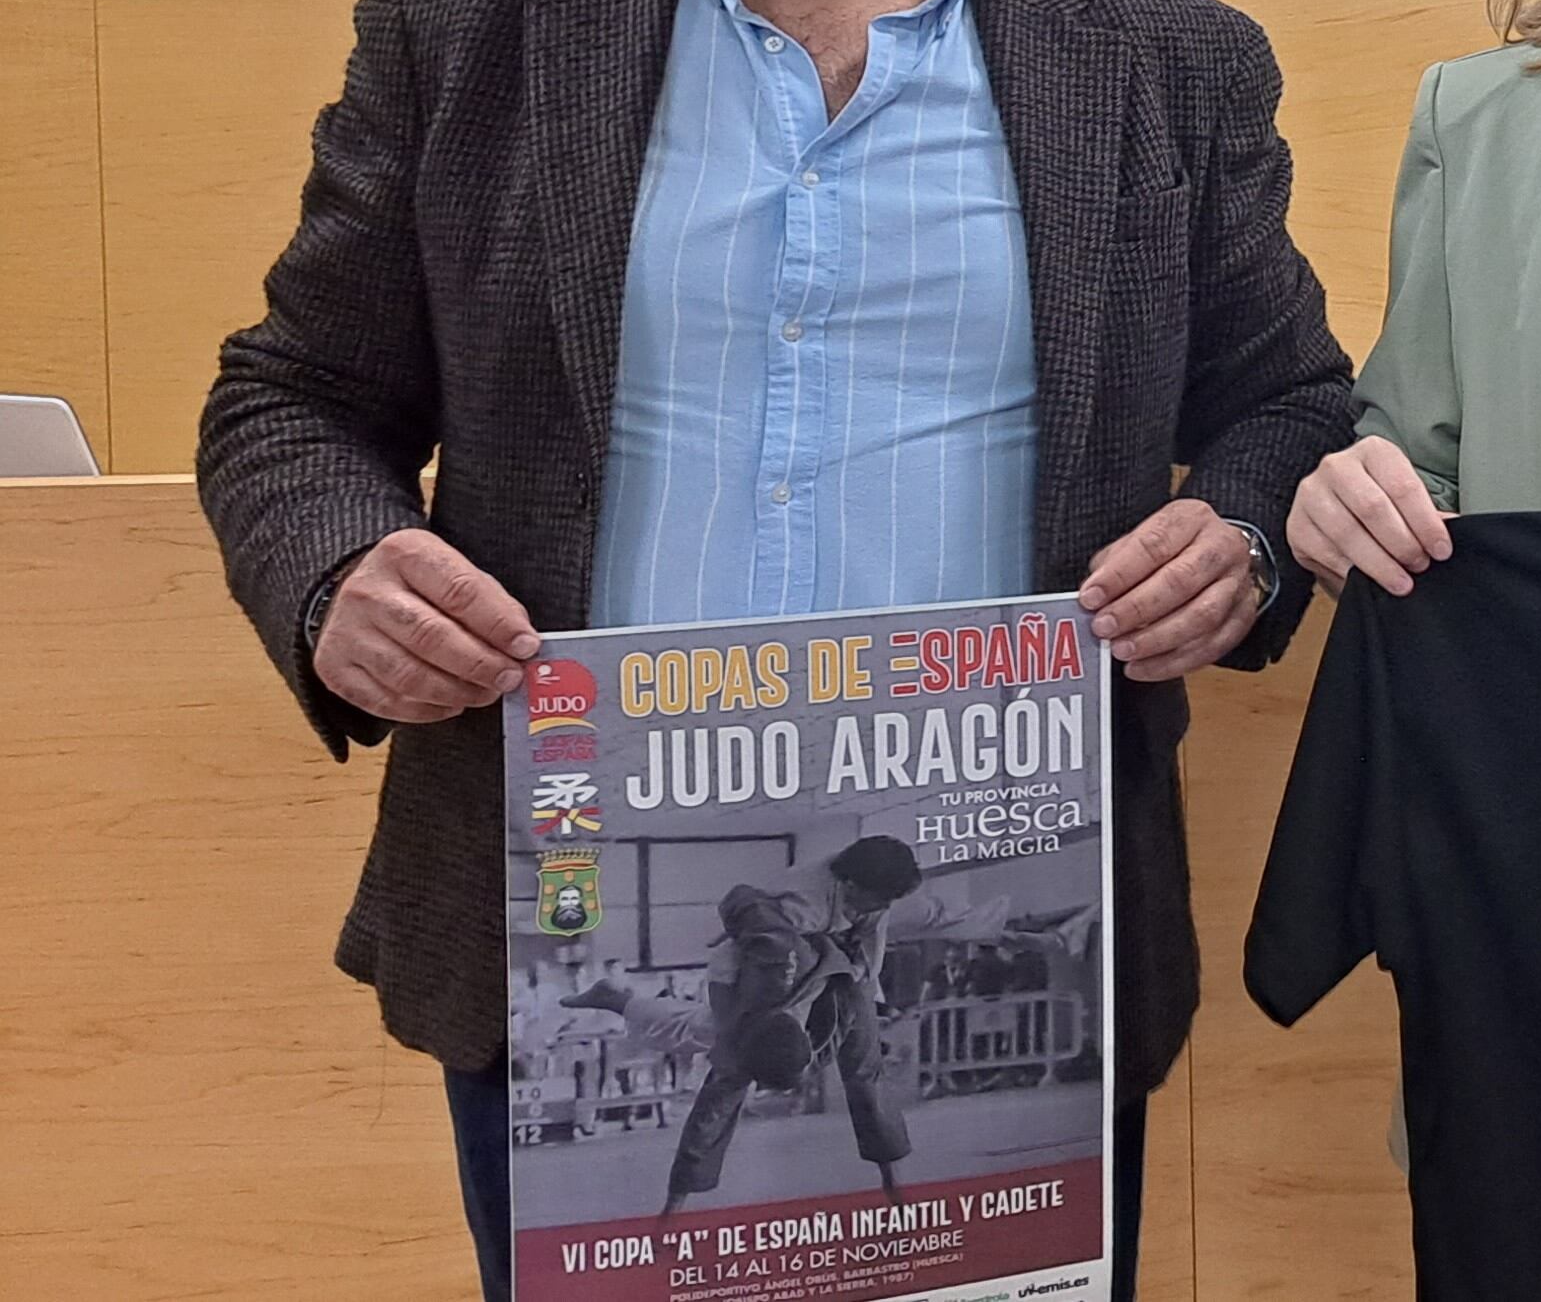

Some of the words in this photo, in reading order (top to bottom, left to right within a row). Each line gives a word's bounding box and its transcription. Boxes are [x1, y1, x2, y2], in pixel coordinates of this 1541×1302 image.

[620, 642, 789, 717] COPAS
[808, 635, 873, 703] DE
[890, 612, 1084, 696] ESPAÑA
[530, 696, 586, 714] JUDO
[626, 720, 800, 810] JUDO
[826, 688, 1084, 794] ARAGÓN
[940, 793, 961, 806] TU
[965, 783, 1060, 804] PROVINCIA
[916, 799, 1085, 843] Huesca
[516, 1125, 542, 1144] 12
[561, 1243, 585, 1273] VI
[594, 1236, 655, 1270] COPA
[718, 1225, 747, 1256] DE
[755, 1211, 844, 1251] ESPAÑA
[852, 1199, 951, 1238] INFANTIL
[959, 1195, 974, 1222] Y
[981, 1180, 1064, 1219] CADETE
[669, 1268, 707, 1288] DEL
[714, 1263, 739, 1282] 14
[744, 1259, 771, 1277] AL
[779, 1255, 802, 1272] 16
[809, 1249, 836, 1269] DE
[843, 1229, 964, 1264] NOVIEMBRE
[807, 1287, 817, 1297] Y
[819, 1285, 832, 1296] LA
